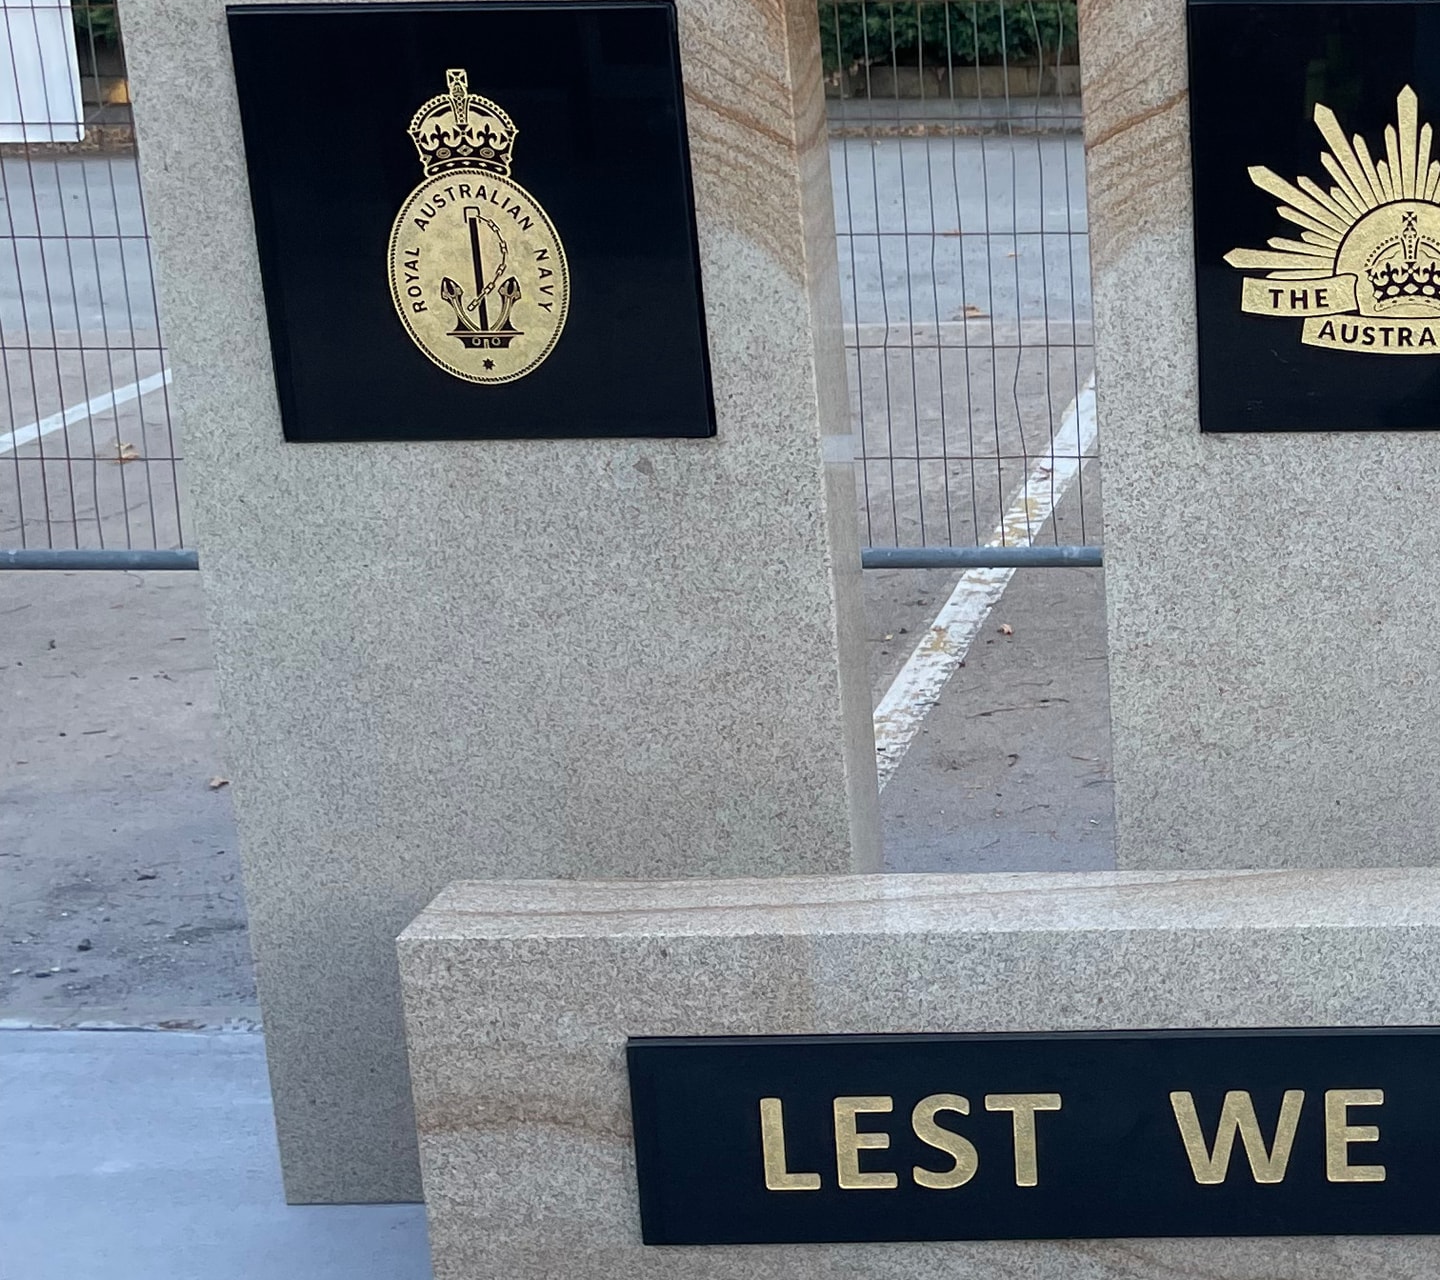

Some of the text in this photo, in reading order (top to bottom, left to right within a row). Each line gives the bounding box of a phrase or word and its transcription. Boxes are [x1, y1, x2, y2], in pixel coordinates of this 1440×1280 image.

[403, 184, 554, 313] ROYAL AUSTRALIAN NAVY
[1268, 287, 1330, 309] THE
[758, 1091, 1062, 1191] LEST
[1168, 1086, 1386, 1185] WE
